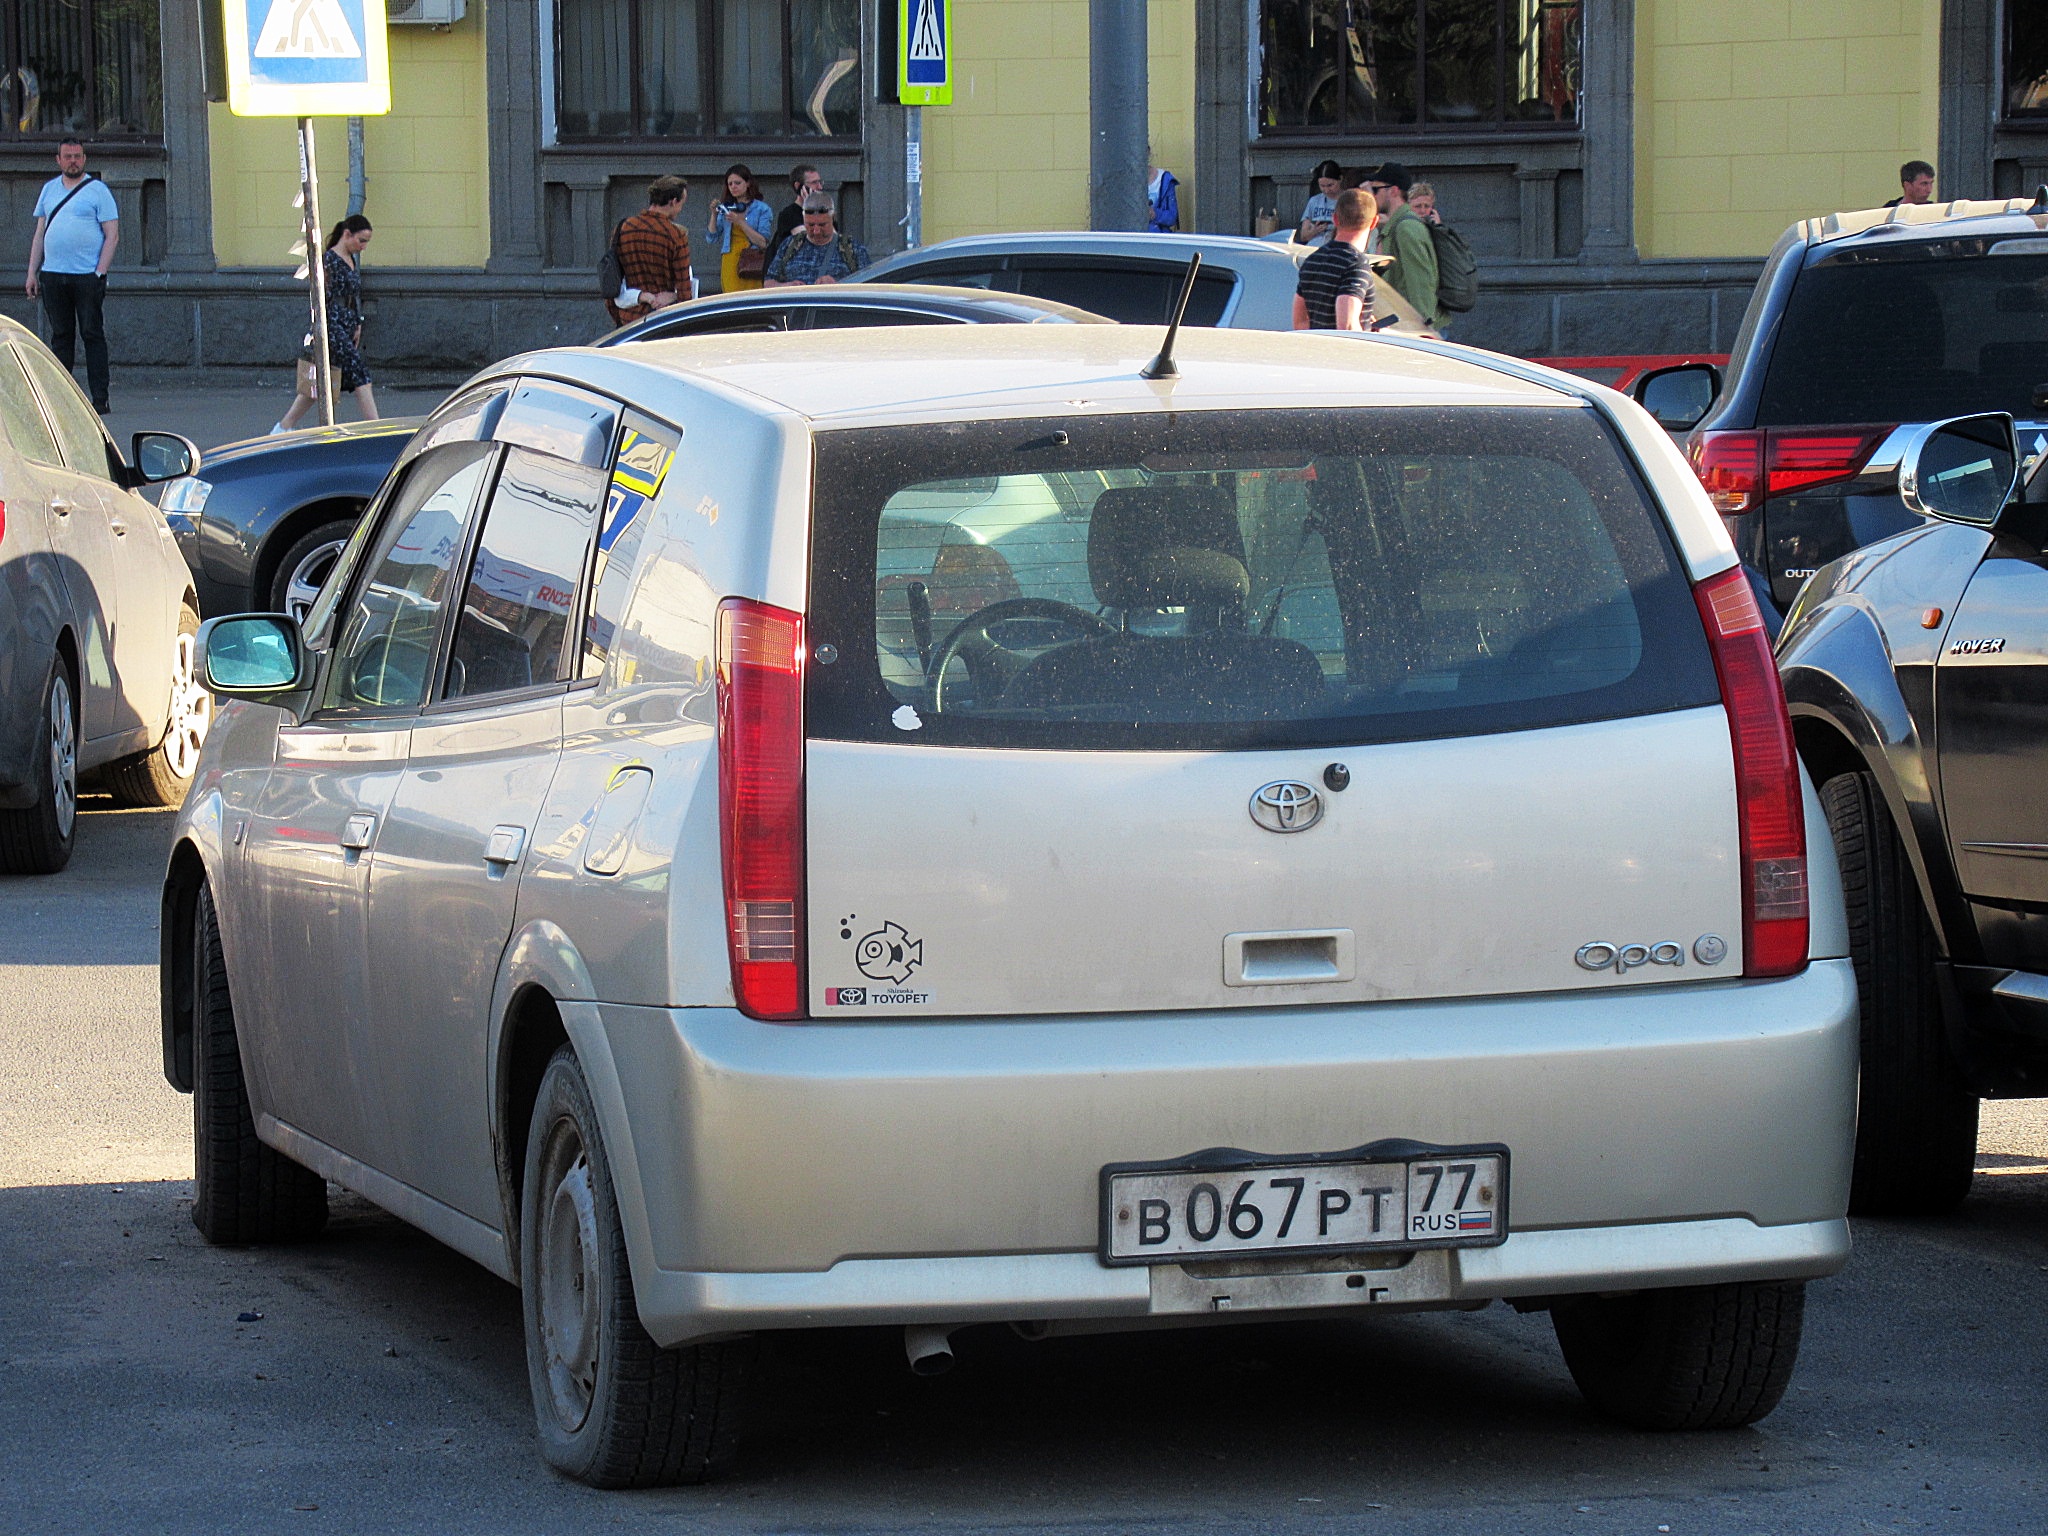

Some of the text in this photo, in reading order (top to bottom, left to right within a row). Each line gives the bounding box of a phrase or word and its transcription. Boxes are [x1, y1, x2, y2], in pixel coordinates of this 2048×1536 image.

[1951, 639, 2004, 653] HOVER
[872, 993, 928, 1004] TOYOPET
[1416, 1163, 1477, 1212] 77
[1412, 1213, 1458, 1232] RUS
